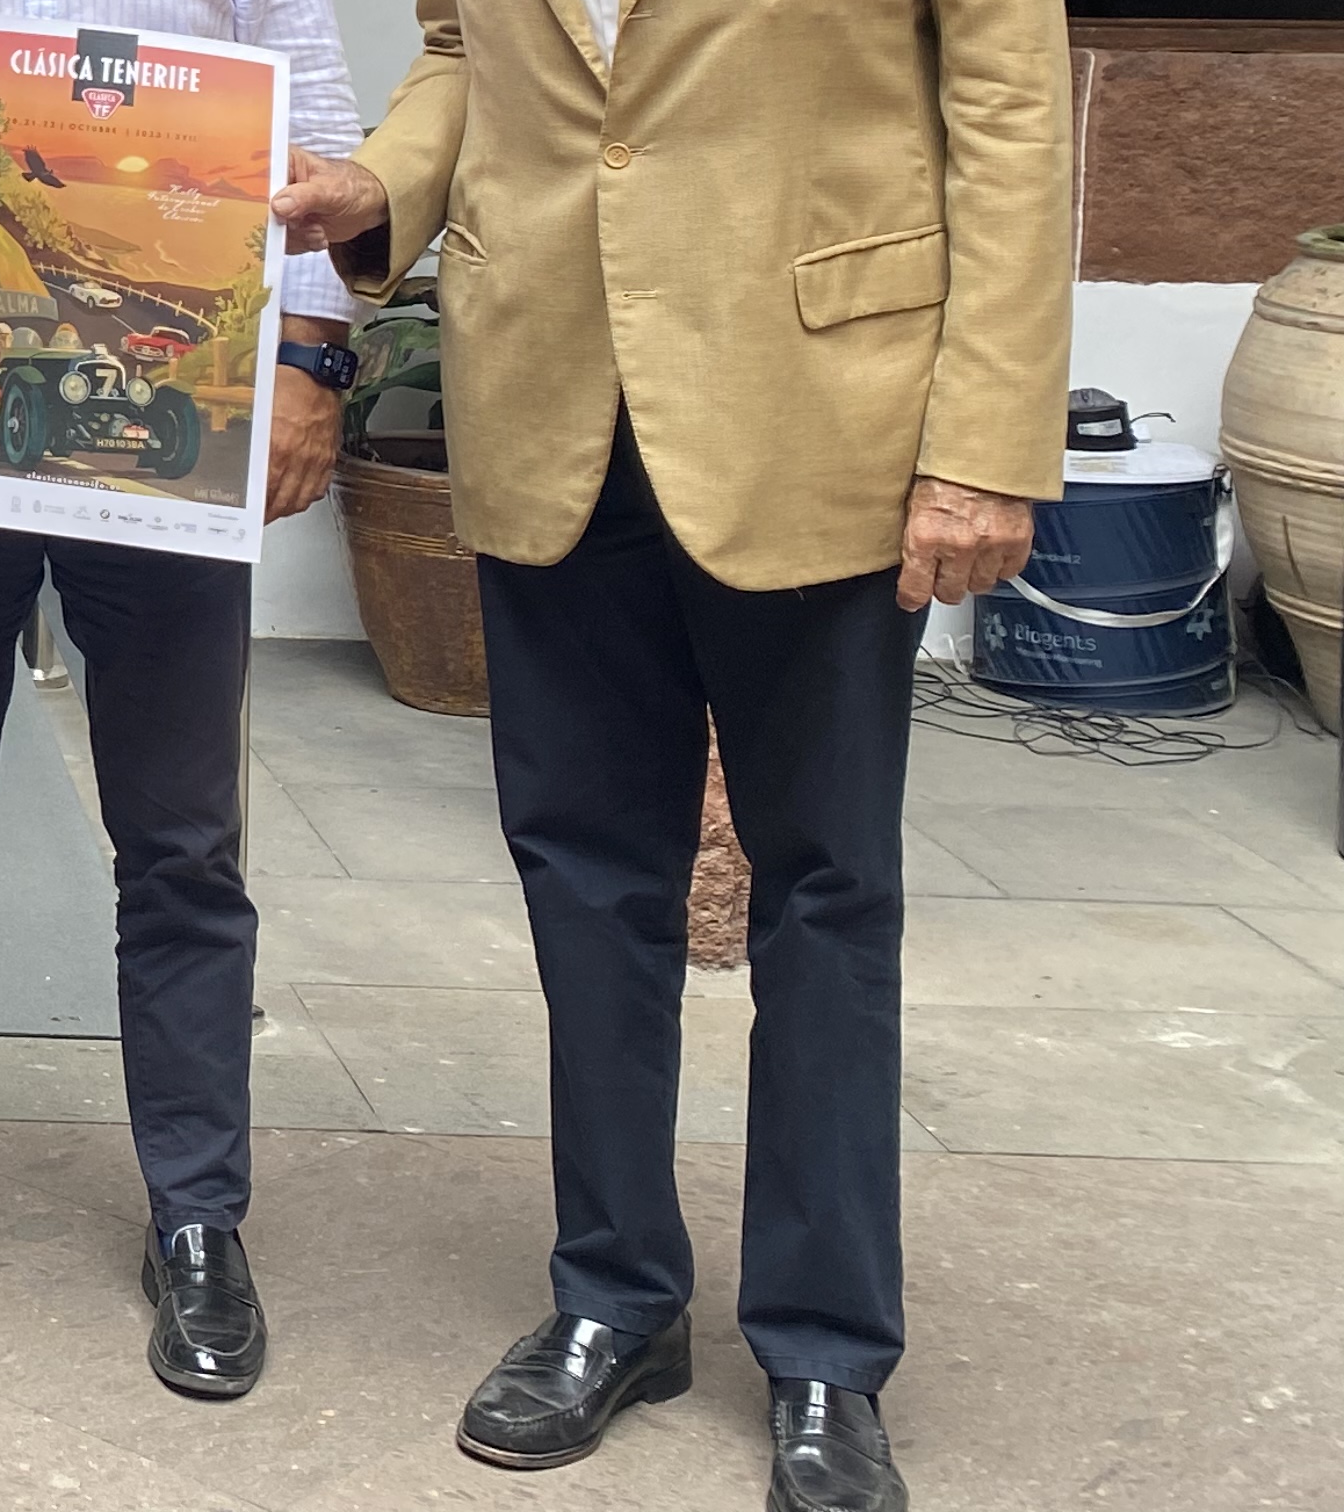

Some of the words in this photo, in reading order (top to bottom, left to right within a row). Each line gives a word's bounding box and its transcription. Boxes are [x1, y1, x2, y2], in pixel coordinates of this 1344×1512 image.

[10, 47, 93, 81] CLÁSICA
[101, 57, 201, 93] TENERIFE
[93, 104, 111, 117] TF
[69, 123, 117, 134] OCTUBRE
[96, 368, 117, 397] 7
[1014, 623, 1097, 651] Biogents
